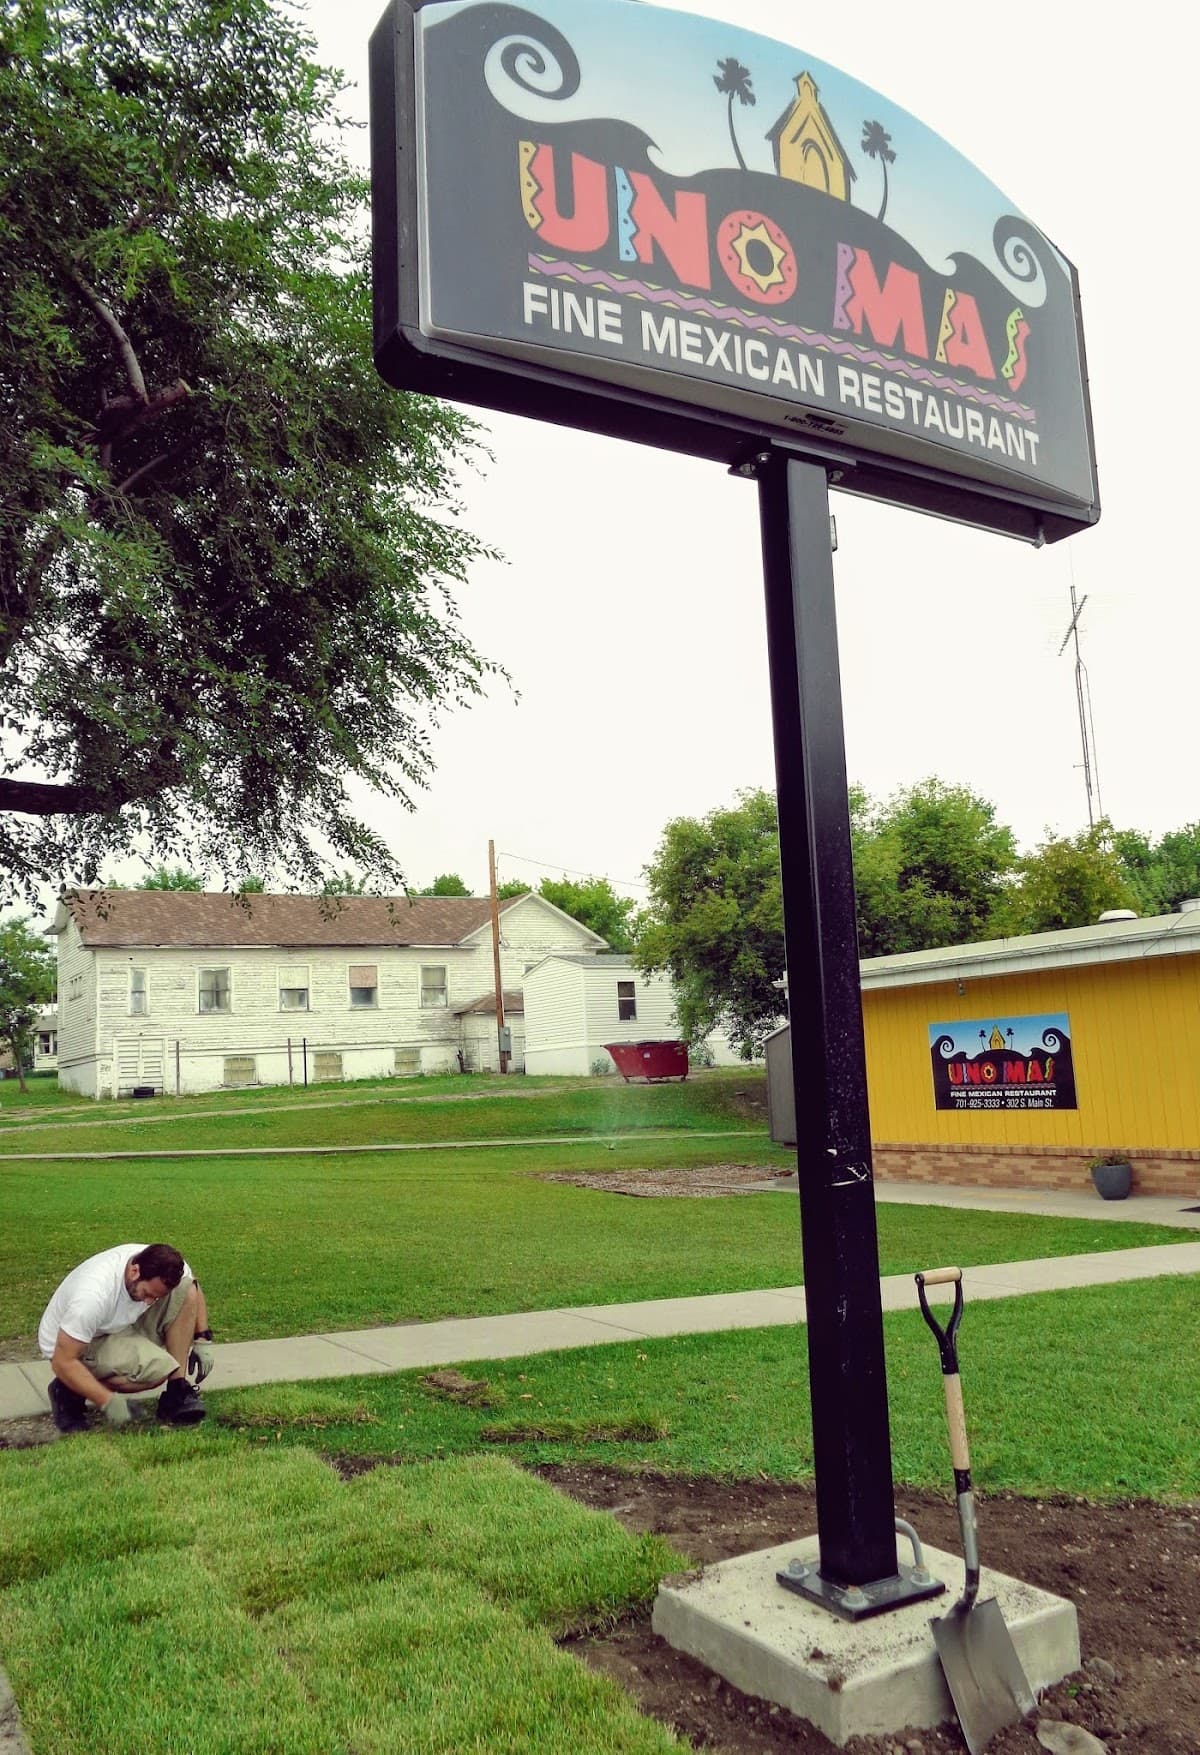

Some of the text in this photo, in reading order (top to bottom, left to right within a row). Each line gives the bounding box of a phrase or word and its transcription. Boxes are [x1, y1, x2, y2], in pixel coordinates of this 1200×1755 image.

[517, 140, 1031, 392] UNO MAS
[522, 281, 1040, 466] FINE MEXICAN RESTAURANT
[947, 1056, 1055, 1085] UNO MAS
[950, 1089, 1057, 1098] FINE MEXICAN RESTAURANT
[955, 1098, 1054, 1109] 701-925-3333 302 S. Main St.
